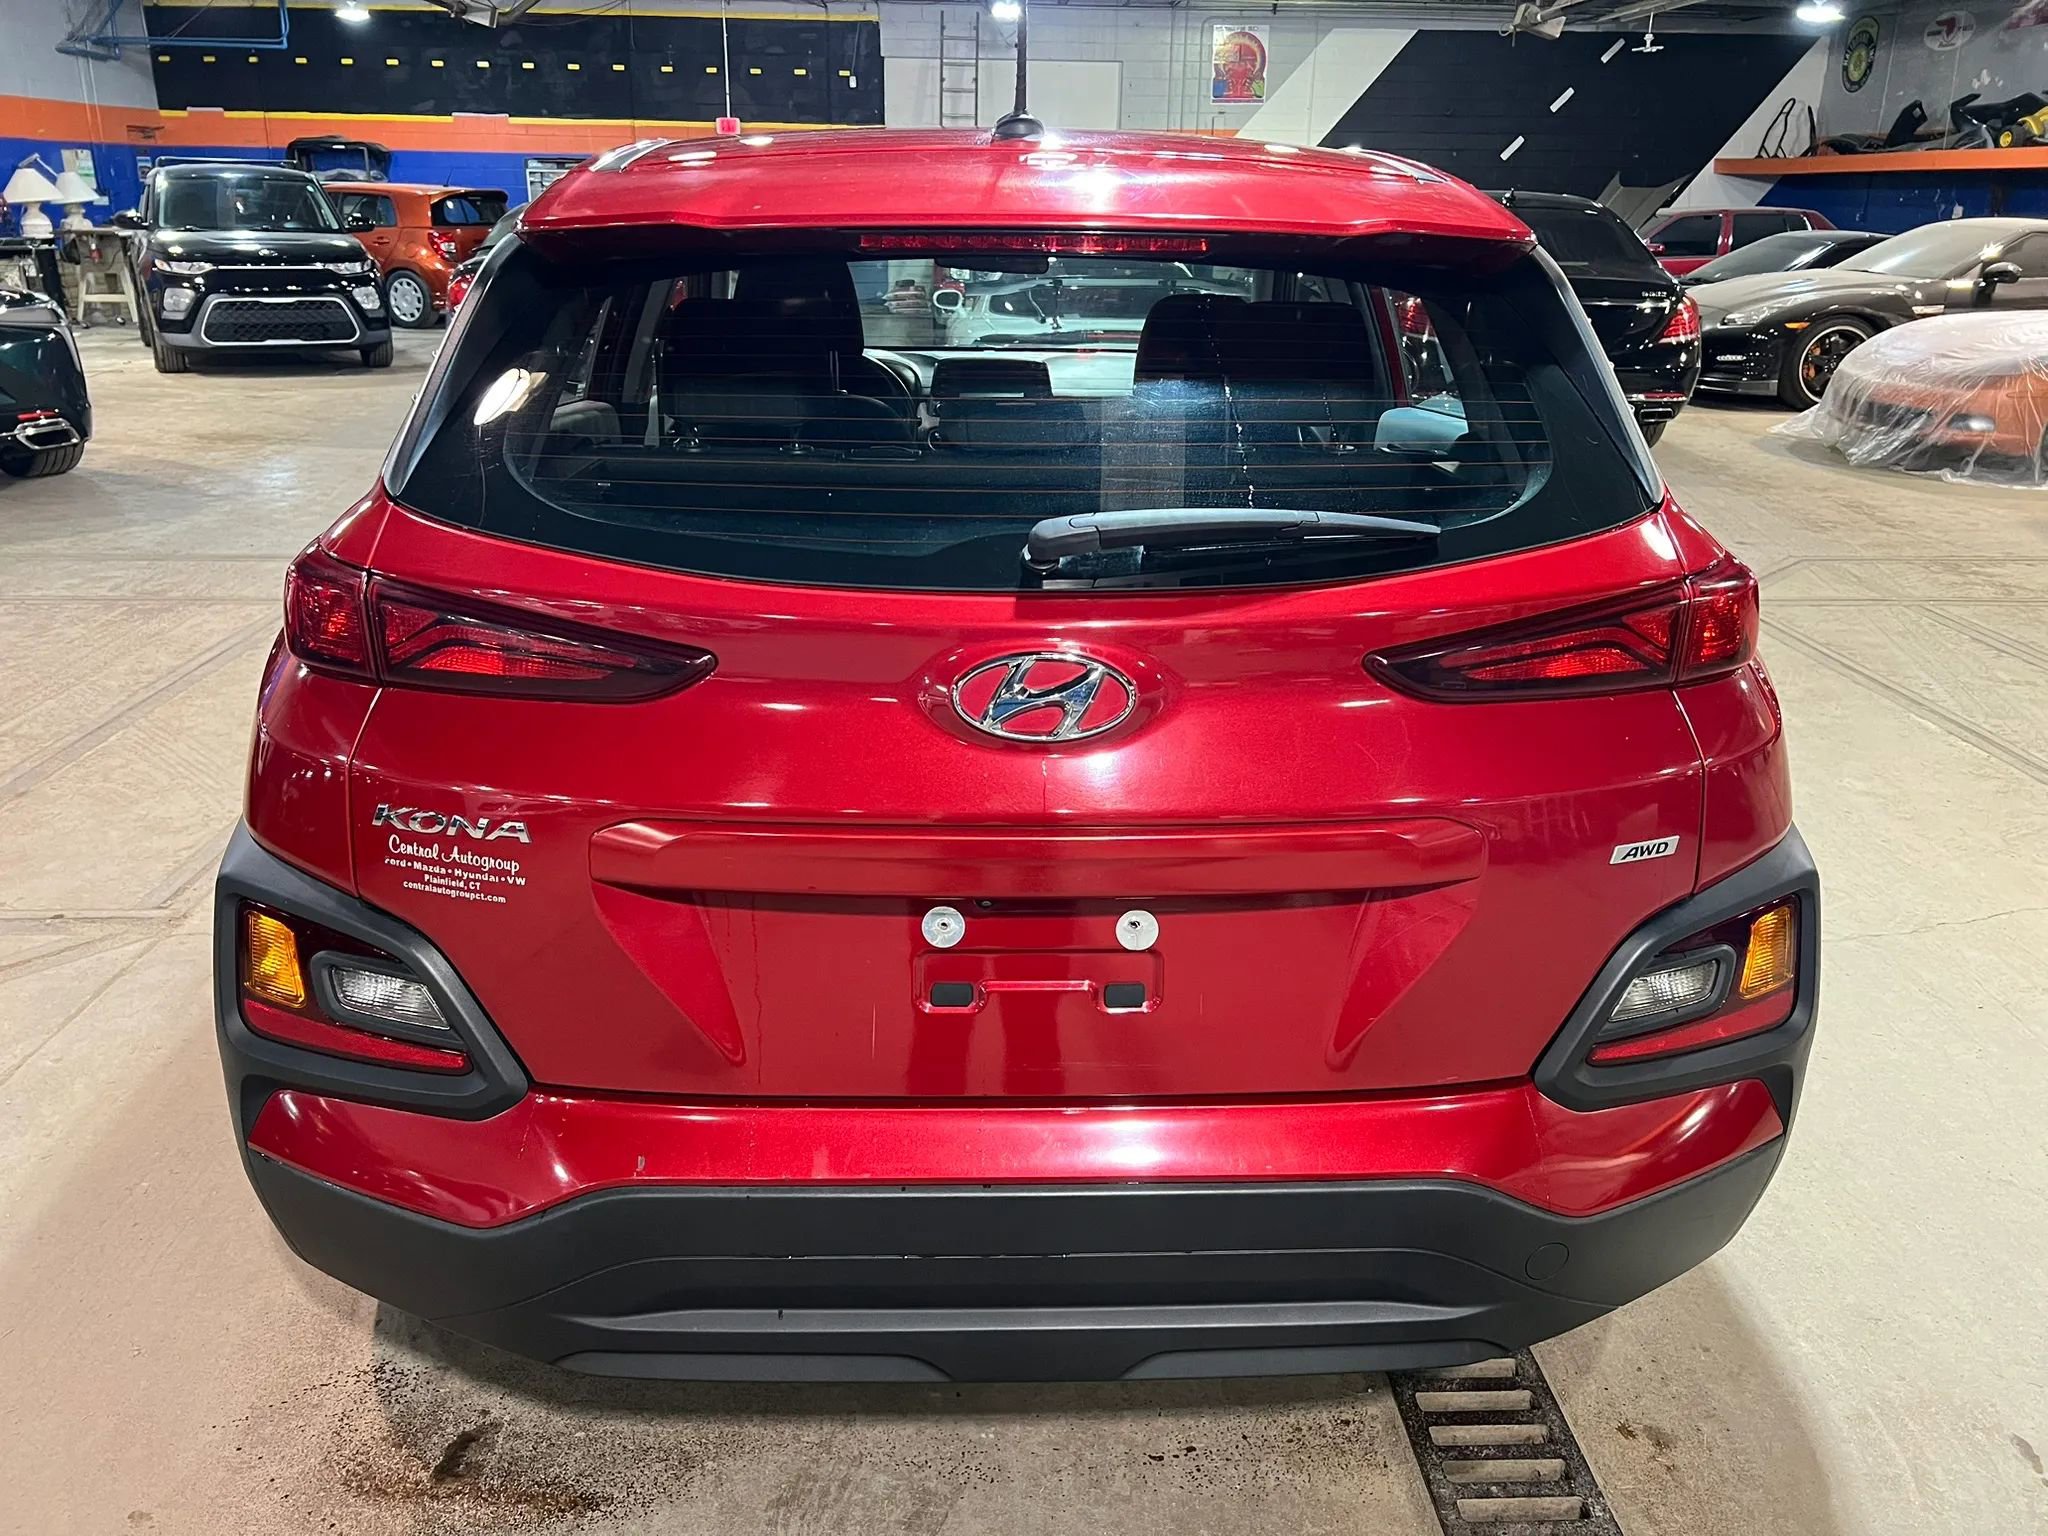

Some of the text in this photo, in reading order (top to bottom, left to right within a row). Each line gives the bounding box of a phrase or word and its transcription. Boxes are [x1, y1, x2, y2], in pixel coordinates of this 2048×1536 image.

[371, 803, 532, 844] KONA
[388, 834, 520, 876] Central Autogroup
[1620, 841, 1669, 861] AWD
[413, 860, 447, 875] Mazda
[507, 875, 527, 886] VW
[403, 881, 507, 904] centralautogroupct.com
[469, 881, 481, 891] CT
